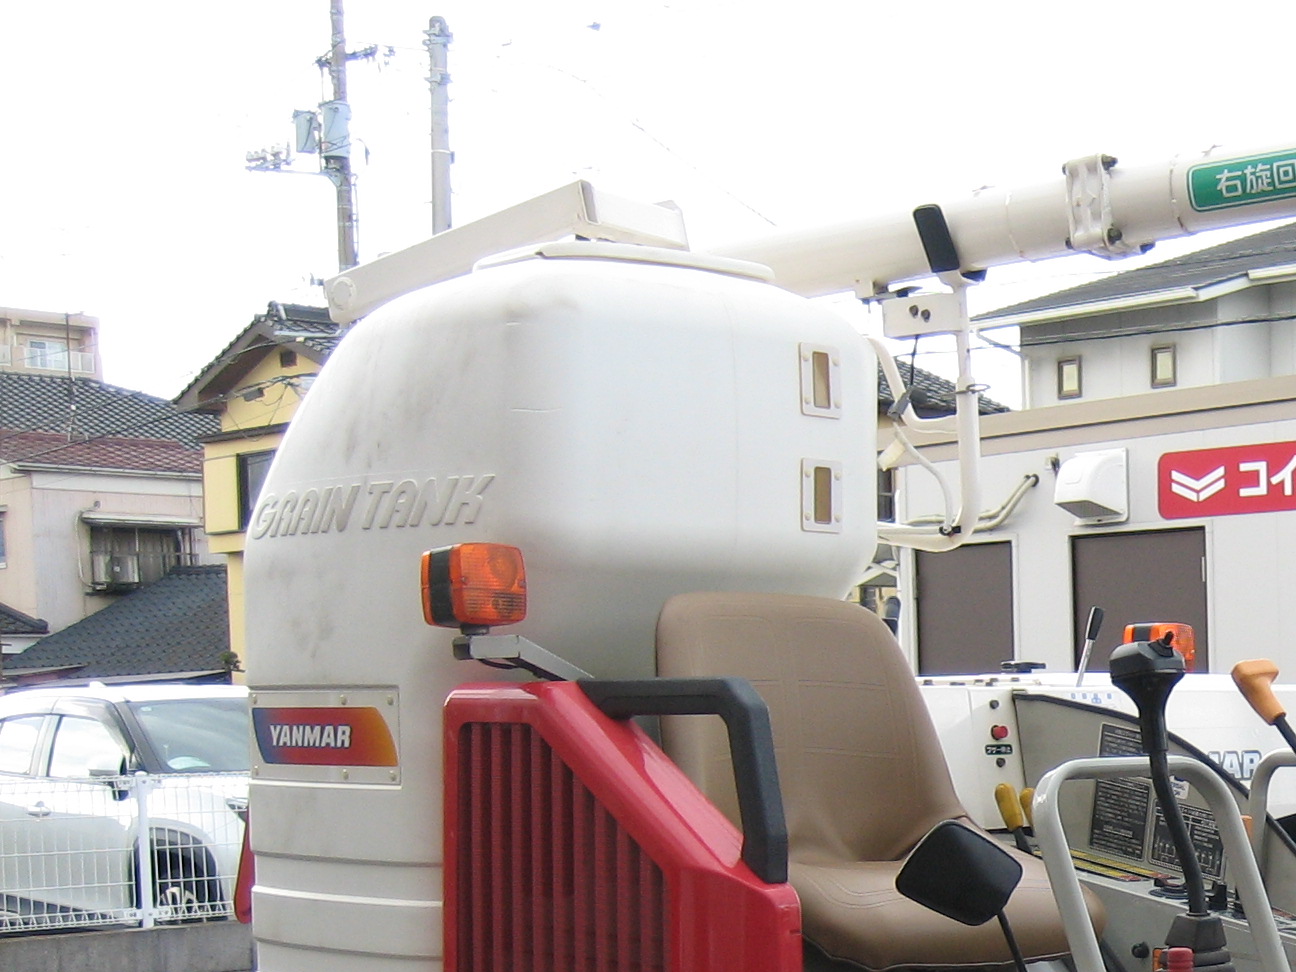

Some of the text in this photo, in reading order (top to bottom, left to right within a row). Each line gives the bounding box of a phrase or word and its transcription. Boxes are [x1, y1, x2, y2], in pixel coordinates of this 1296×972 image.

[252, 473, 496, 540] GRAIN TANK
[269, 724, 352, 749] YANMAR
